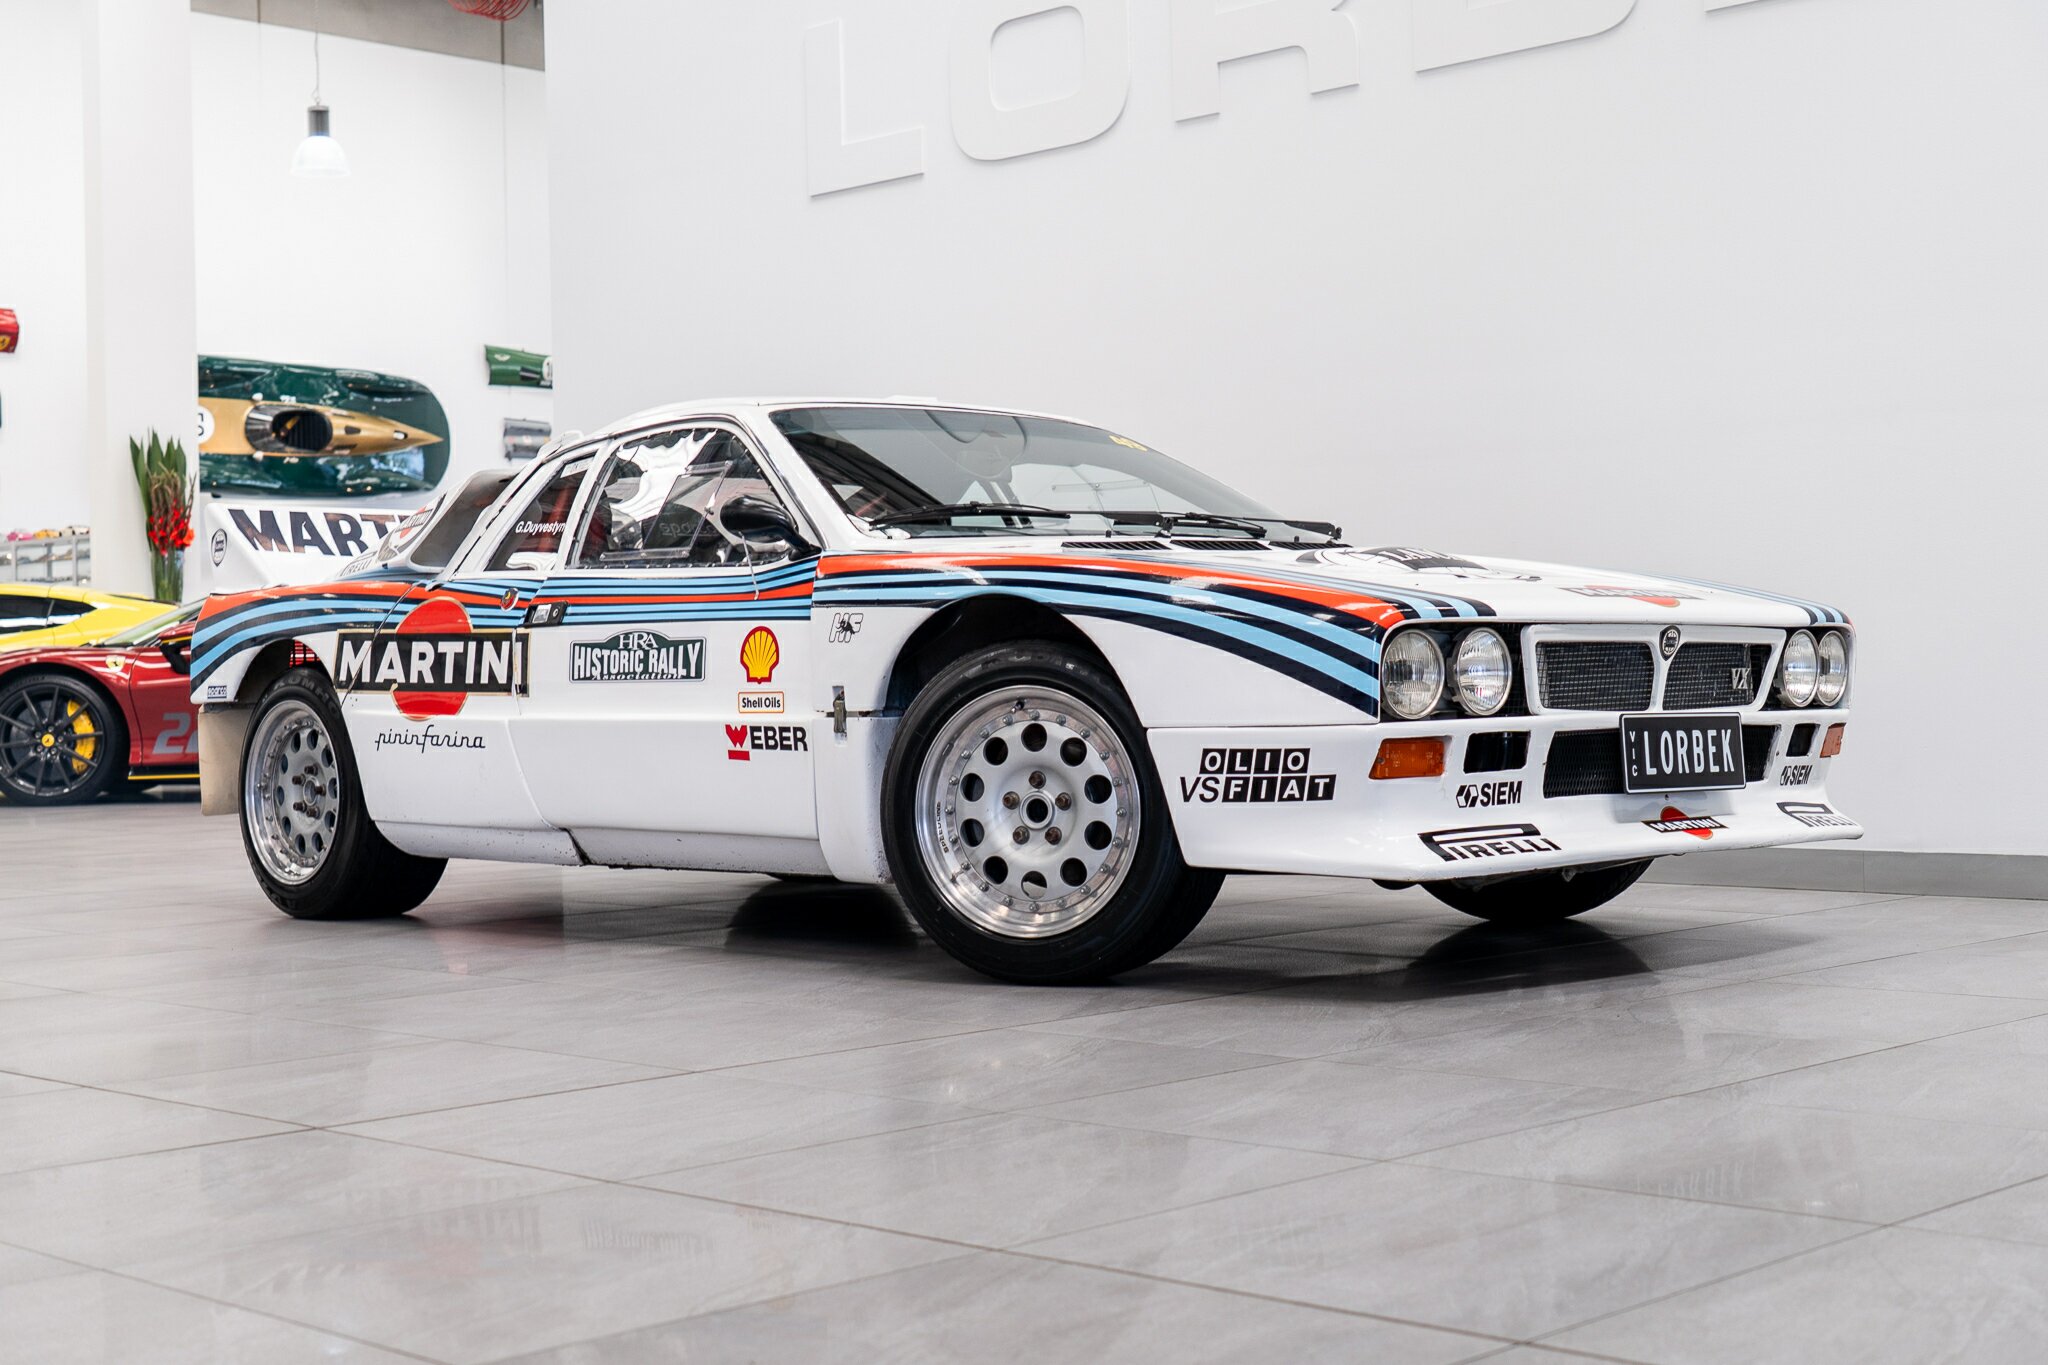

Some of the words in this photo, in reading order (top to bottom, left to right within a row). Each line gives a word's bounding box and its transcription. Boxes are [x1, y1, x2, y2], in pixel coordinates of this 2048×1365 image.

[228, 508, 408, 557] MART
[618, 632, 659, 650] HRA
[338, 640, 523, 685] MARTINI
[573, 645, 644, 681] HISTORIC
[648, 642, 701, 678] RALLY
[741, 697, 763, 709] Shell
[764, 697, 781, 709] Oils
[374, 724, 486, 753] pininfarina
[725, 724, 809, 752] WEBER
[1202, 750, 1306, 773] OLIO
[1643, 729, 1735, 776] LORBEK
[1790, 765, 1813, 786] SIEM
[1480, 781, 1523, 808] SIEM
[1649, 818, 1721, 832] MARTINI
[1417, 823, 1562, 862] PIRELLI
